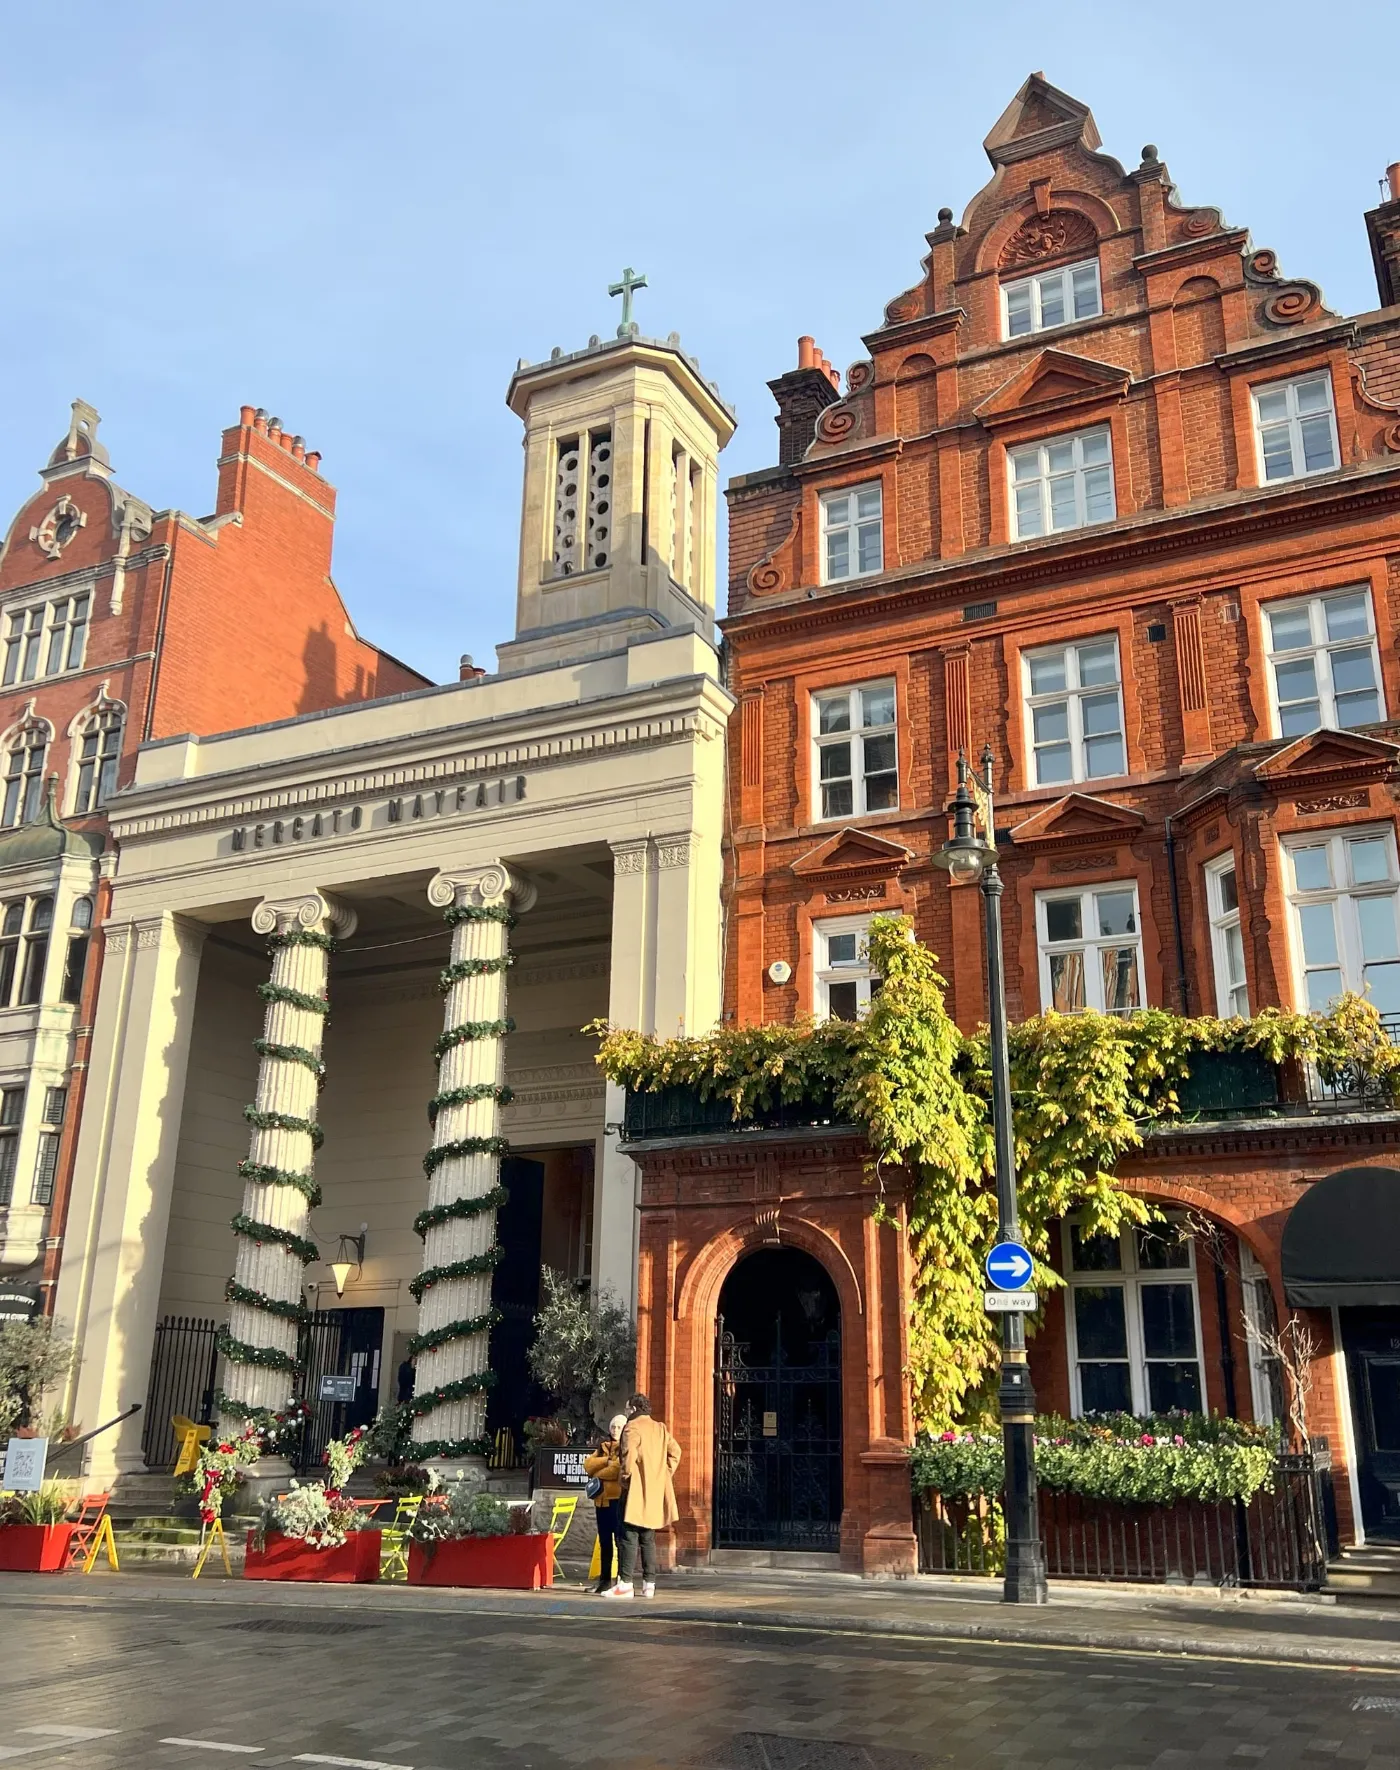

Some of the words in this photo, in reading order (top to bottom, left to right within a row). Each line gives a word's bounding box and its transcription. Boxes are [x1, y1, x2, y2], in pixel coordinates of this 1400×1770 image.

[231, 805, 363, 851] MERCATO
[387, 775, 528, 823] MAYFAIR
[988, 1297, 1009, 1306] One
[1011, 1298, 1032, 1307] way
[554, 1453, 578, 1464] PLEASE
[553, 1464, 566, 1475] OUR
